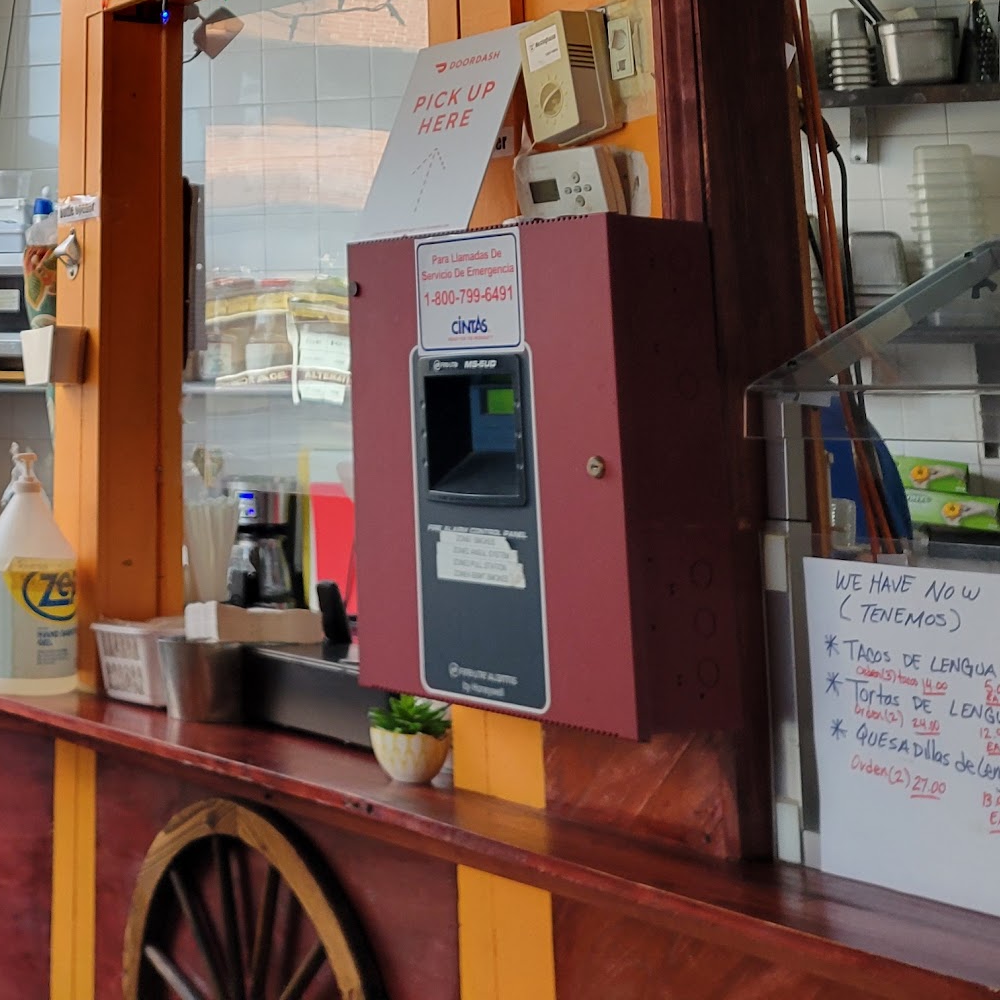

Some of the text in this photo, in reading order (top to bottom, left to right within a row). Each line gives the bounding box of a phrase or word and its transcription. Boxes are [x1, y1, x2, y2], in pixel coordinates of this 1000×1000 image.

[449, 50, 501, 70] DOORDASH
[413, 80, 496, 113] PICK UP
[418, 109, 473, 135] HERE
[432, 248, 502, 264] Para Llamadas De
[421, 264, 515, 281] Servicio De Emergencia
[423, 285, 514, 307] 1-800-799-6491
[836, 570, 981, 602] WE HAVE NOW
[843, 639, 998, 678] TACOS DE LENGUA
[913, 695, 932, 714] DE
[911, 775, 947, 795] 27.00
